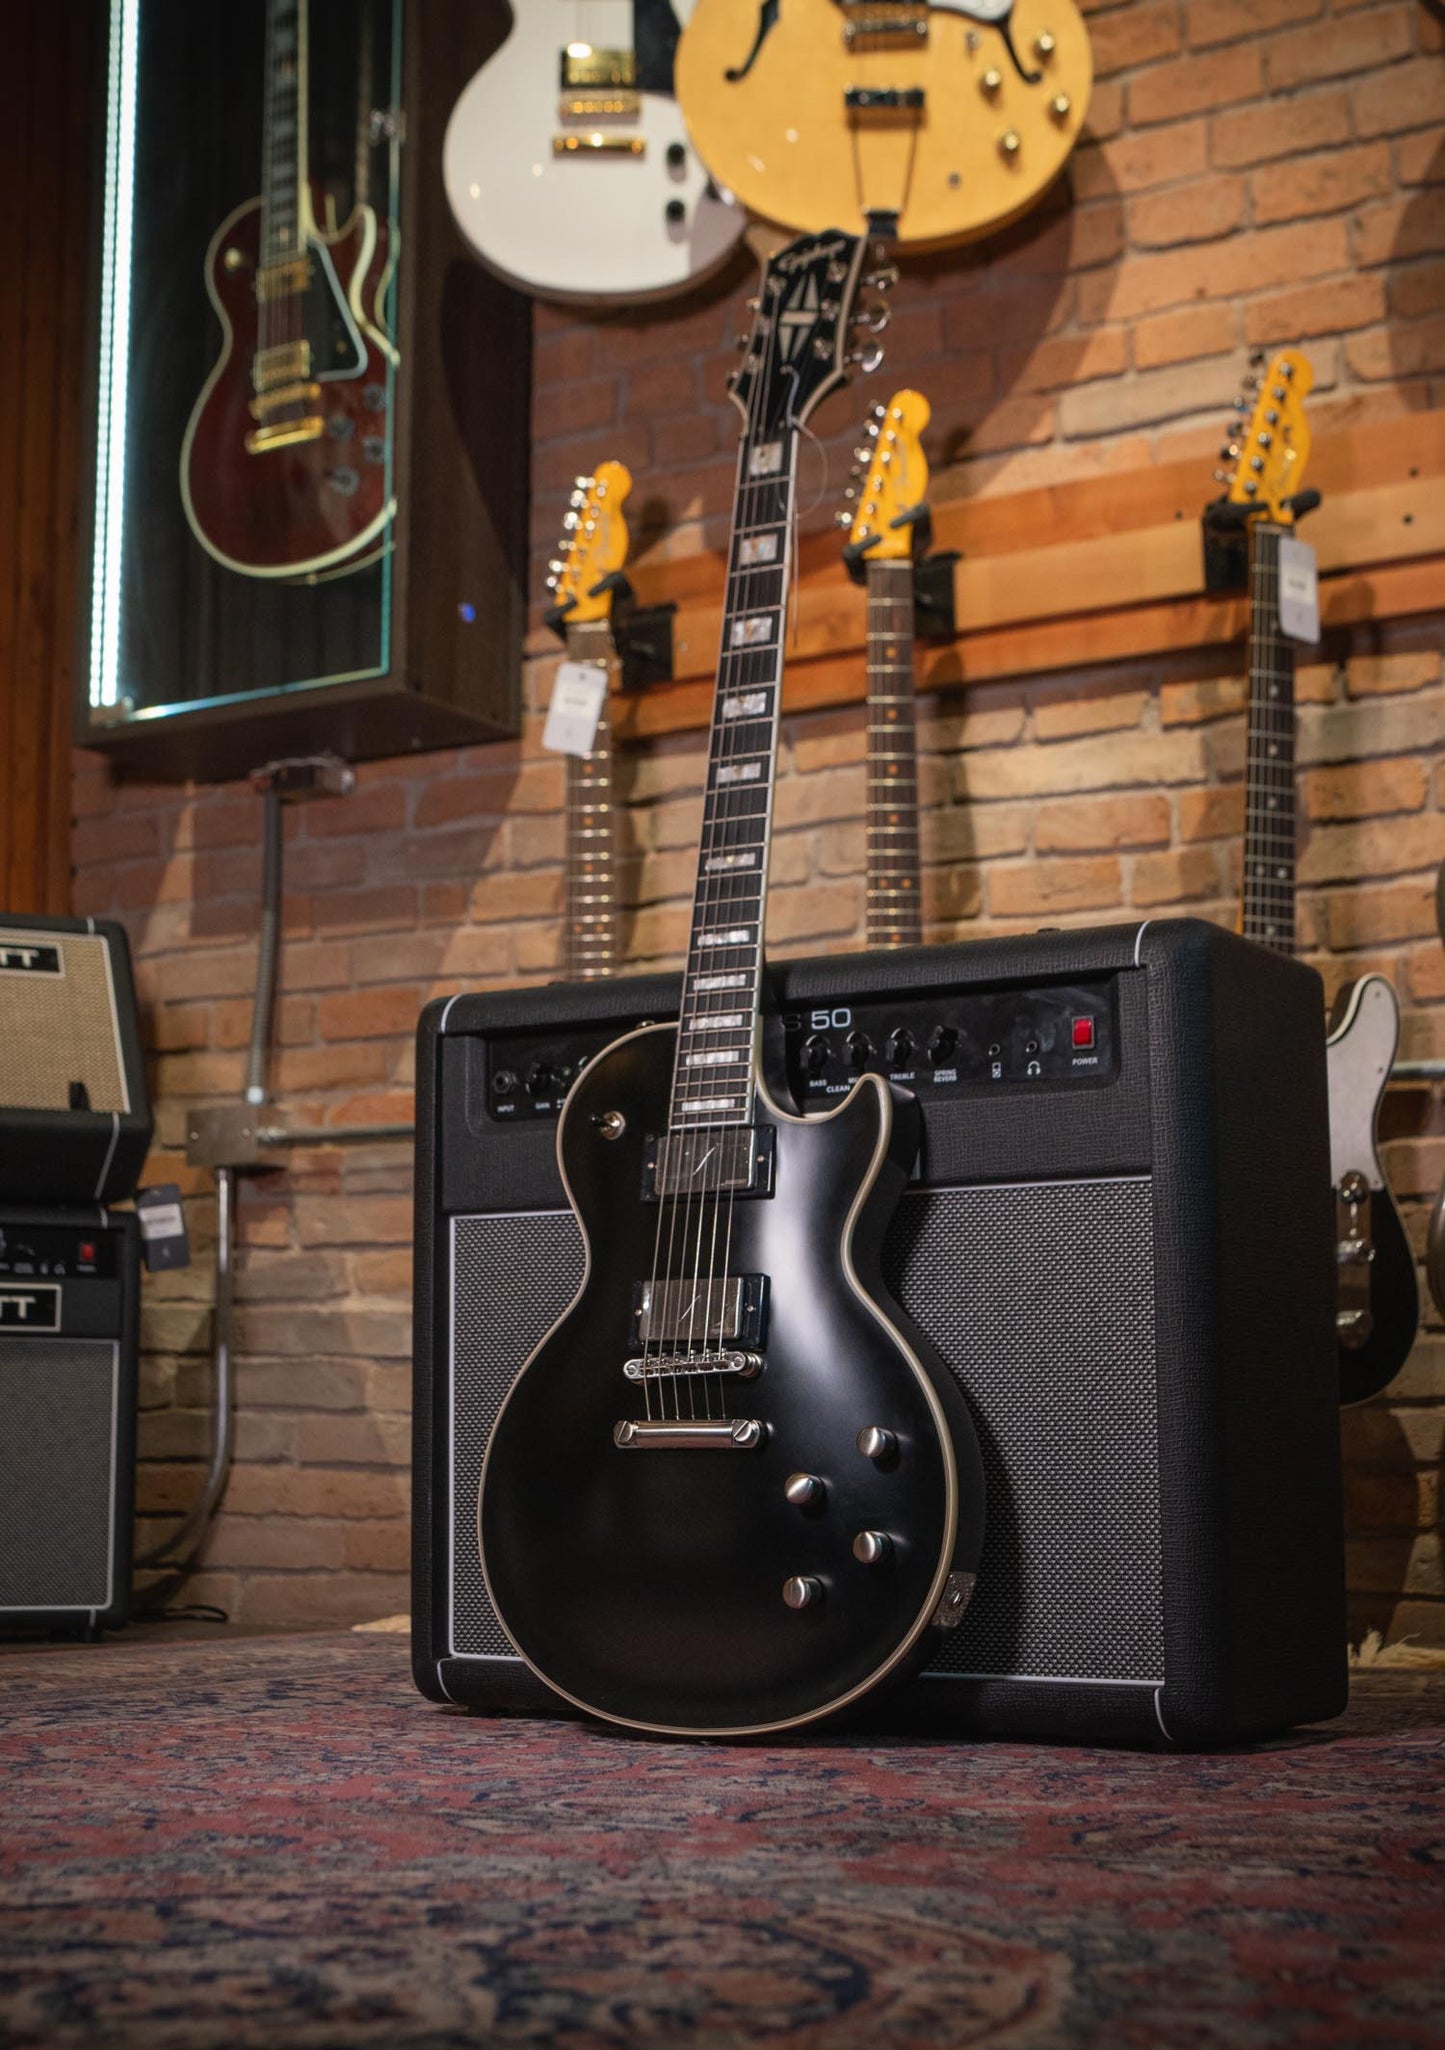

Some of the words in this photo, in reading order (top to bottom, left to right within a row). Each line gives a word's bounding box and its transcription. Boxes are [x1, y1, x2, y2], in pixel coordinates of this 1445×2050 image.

[811, 1008, 851, 1030] 50
[1072, 1056, 1098, 1066] POWER
[890, 1072, 915, 1080] TREBLE
[809, 1079, 827, 1087] BASS
[826, 1085, 851, 1093] CLEAN
